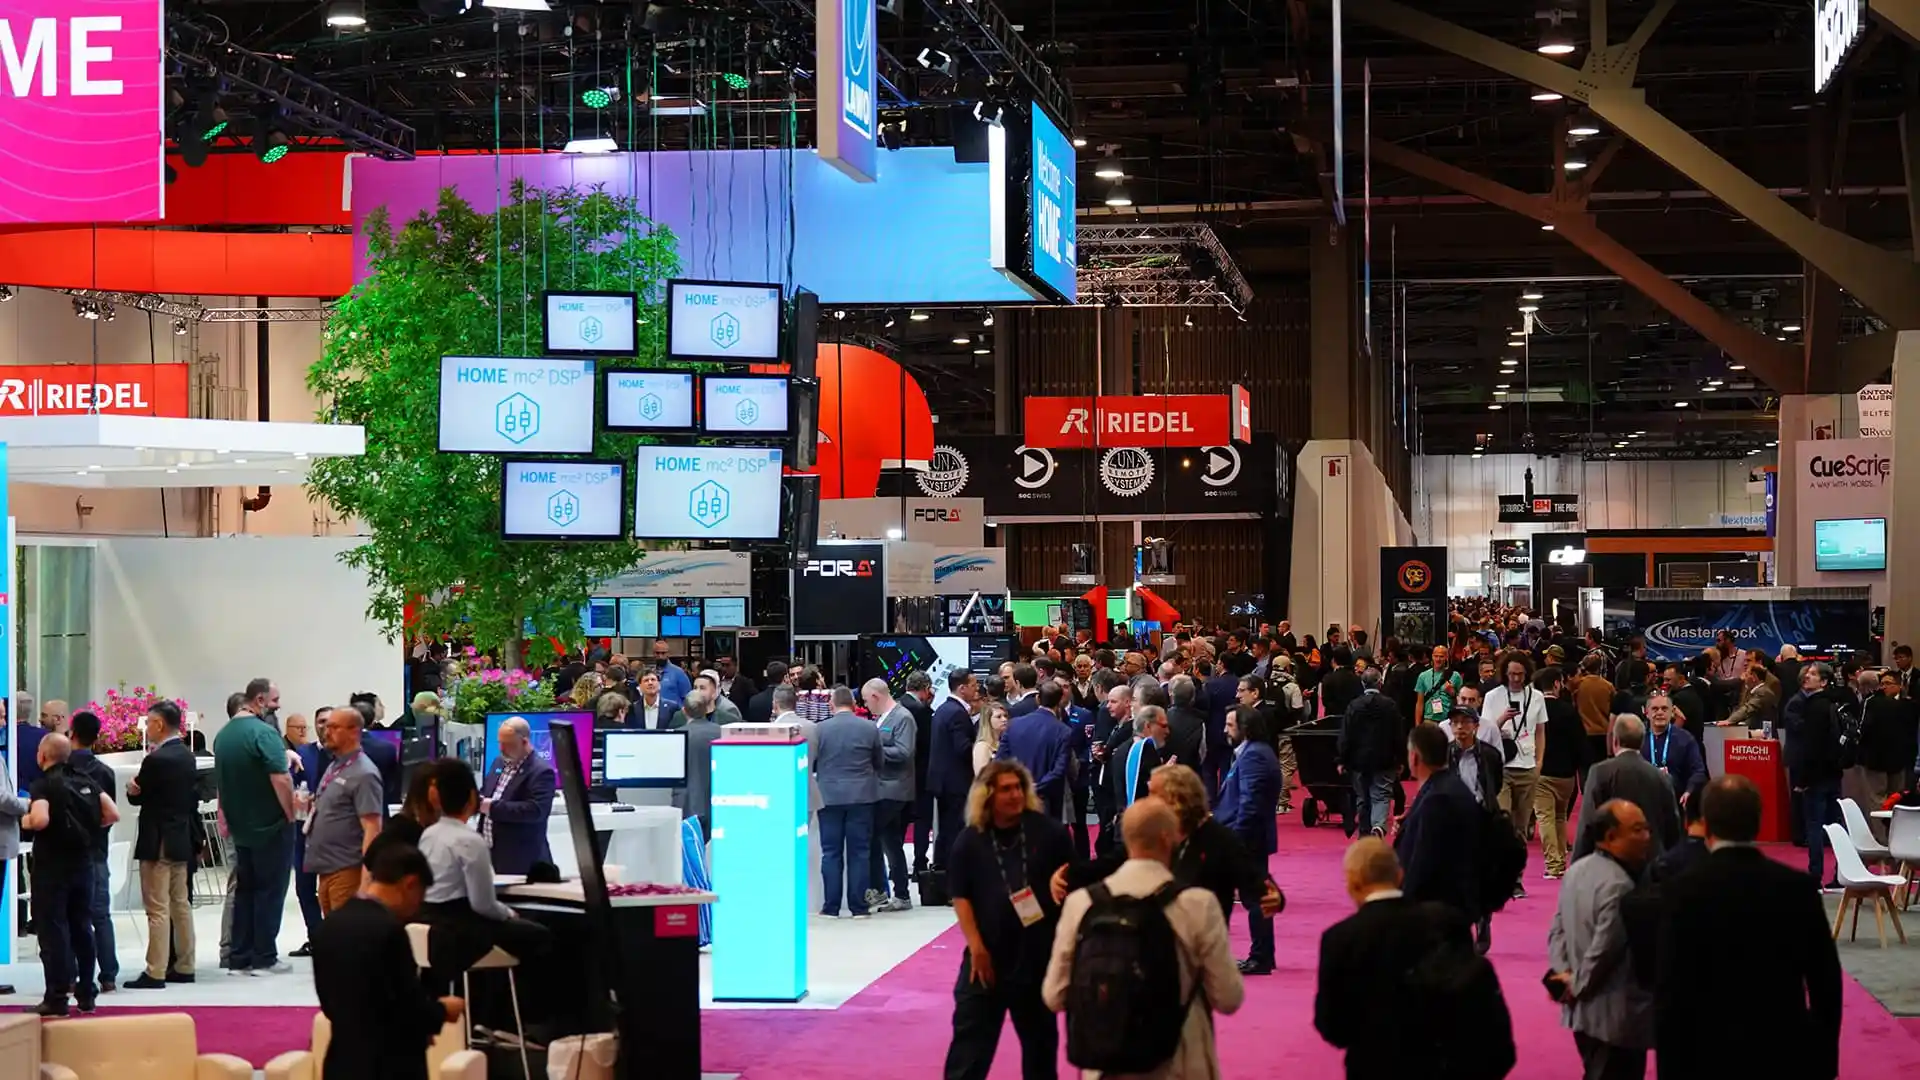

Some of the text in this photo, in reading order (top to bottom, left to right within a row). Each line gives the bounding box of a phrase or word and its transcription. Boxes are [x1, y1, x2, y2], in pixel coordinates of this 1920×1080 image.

[0, 16, 124, 97] ME
[1038, 190, 1062, 263] HOME
[685, 293, 718, 306] HOME
[559, 303, 585, 312] HOME
[457, 367, 507, 383] HOME
[549, 370, 581, 386] DSP
[619, 379, 644, 388] HOME
[46, 383, 149, 409] RIEDEL
[716, 385, 741, 394] HOME
[1108, 412, 1194, 433] RIEDEL
[656, 456, 701, 472] HOME
[738, 458, 767, 473] DSP
[1110, 451, 1146, 469] LUNA
[520, 472, 556, 483] HOME
[585, 473, 608, 484] DSP
[1110, 476, 1145, 489] SYSTEMS
[1731, 745, 1769, 754] HITACHI
